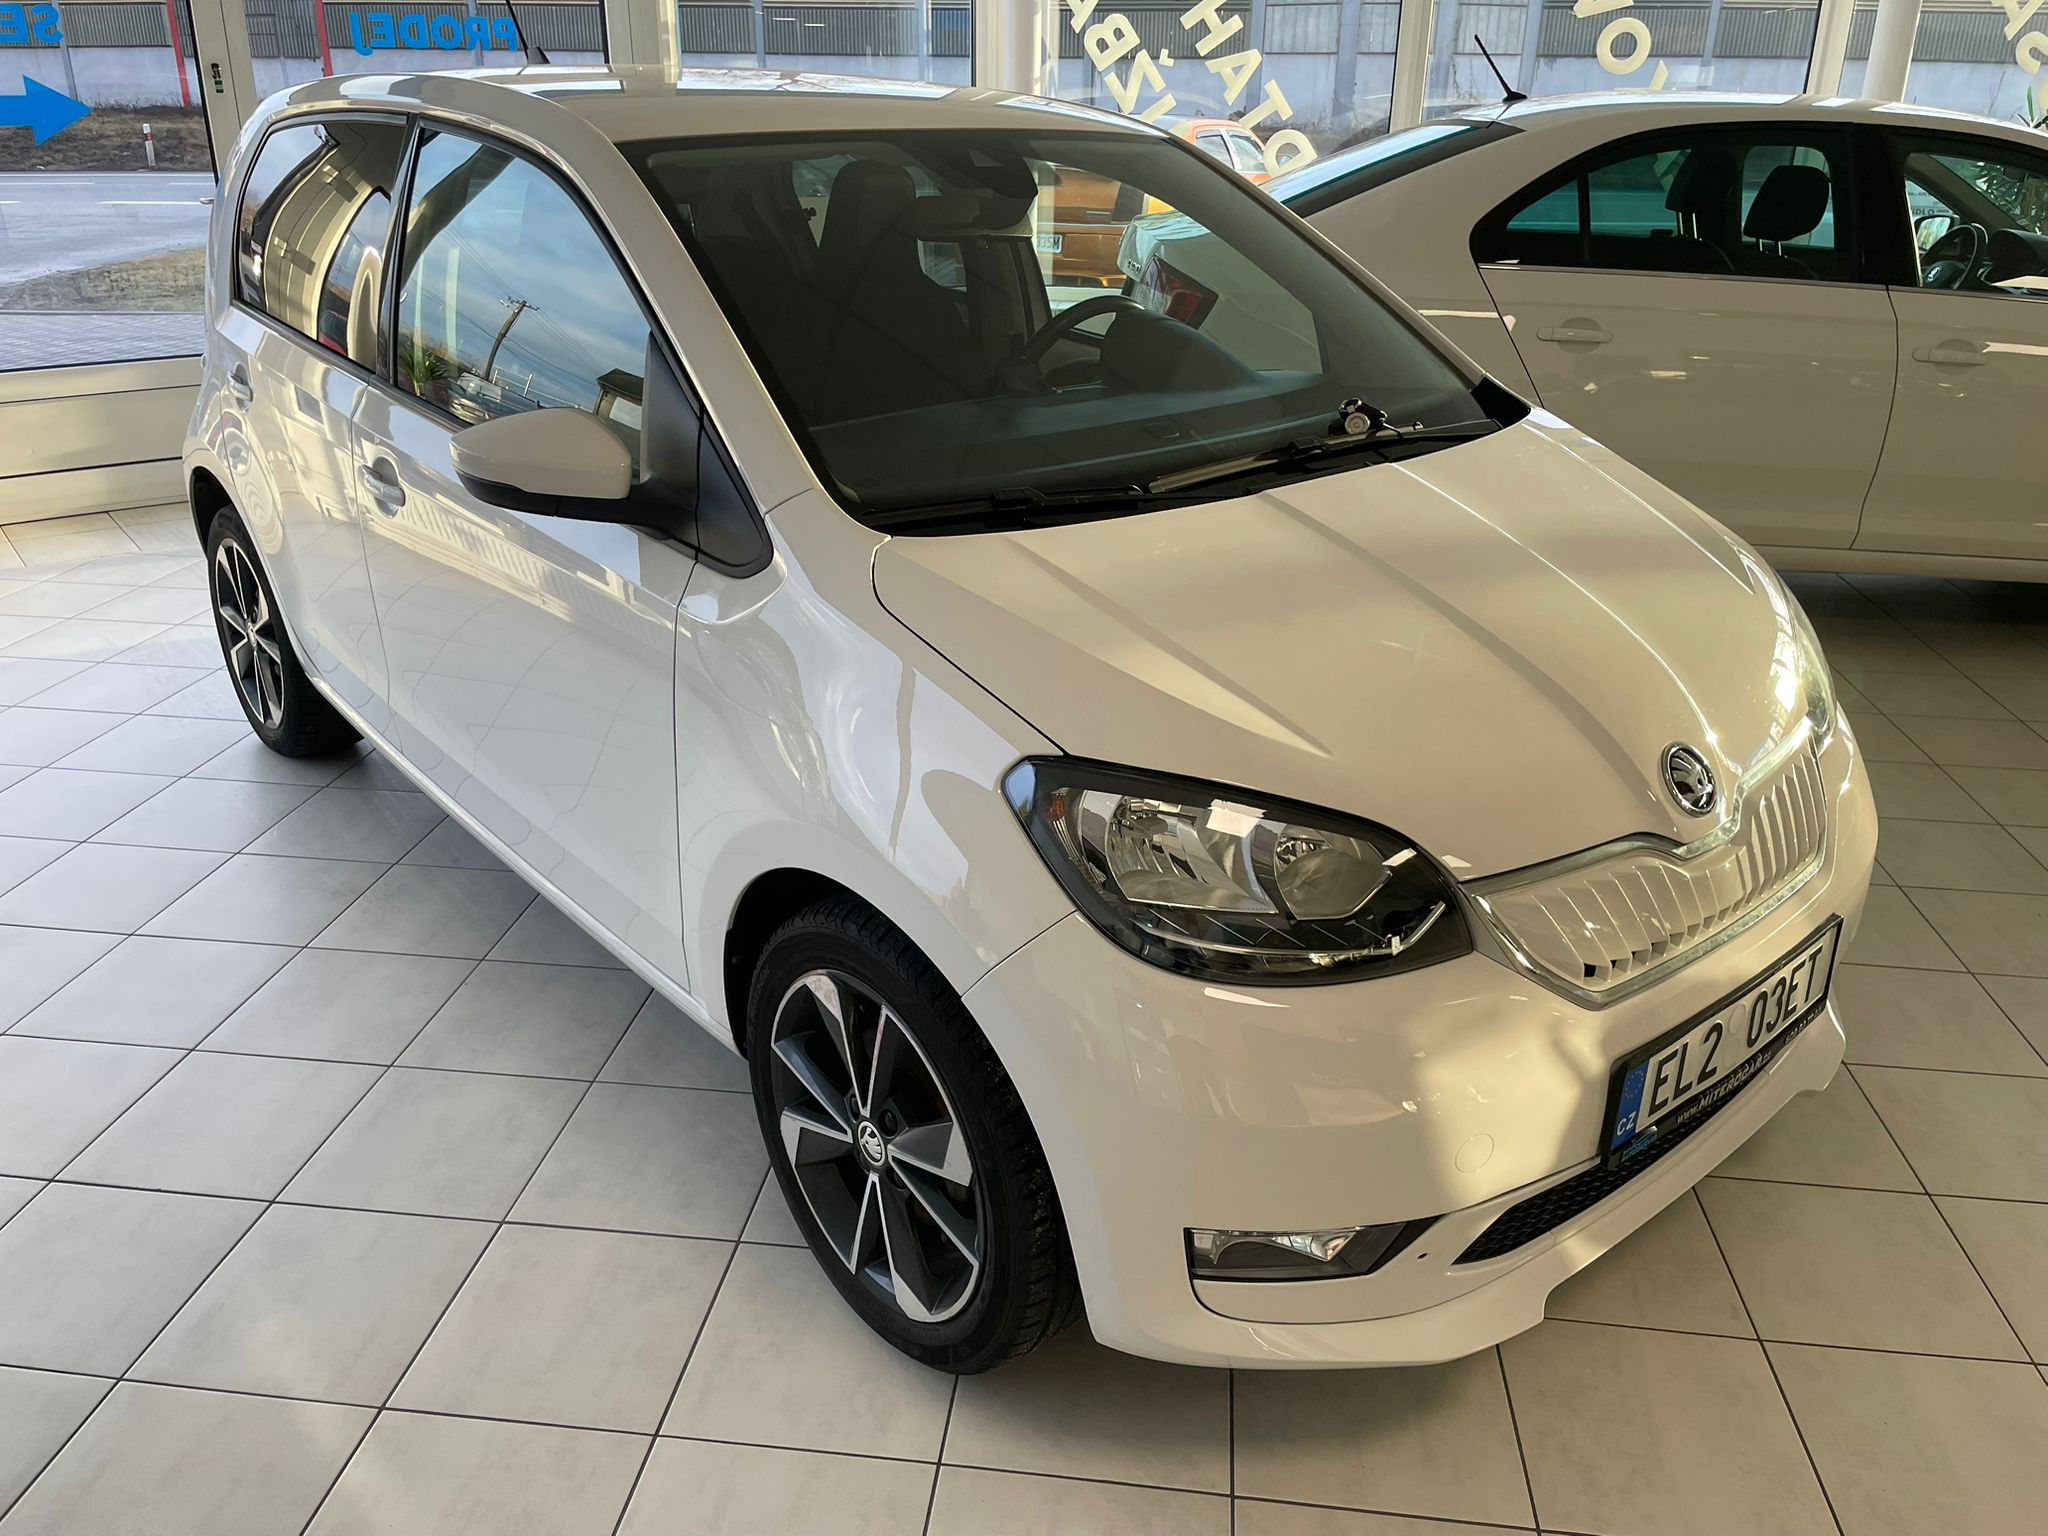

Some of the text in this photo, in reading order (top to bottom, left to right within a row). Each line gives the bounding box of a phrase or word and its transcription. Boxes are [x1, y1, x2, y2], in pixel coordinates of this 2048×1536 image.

[1648, 1021, 1723, 1118] EL2
[1747, 944, 1823, 1048] 03ET
[1617, 1110, 1637, 1136] CZ
